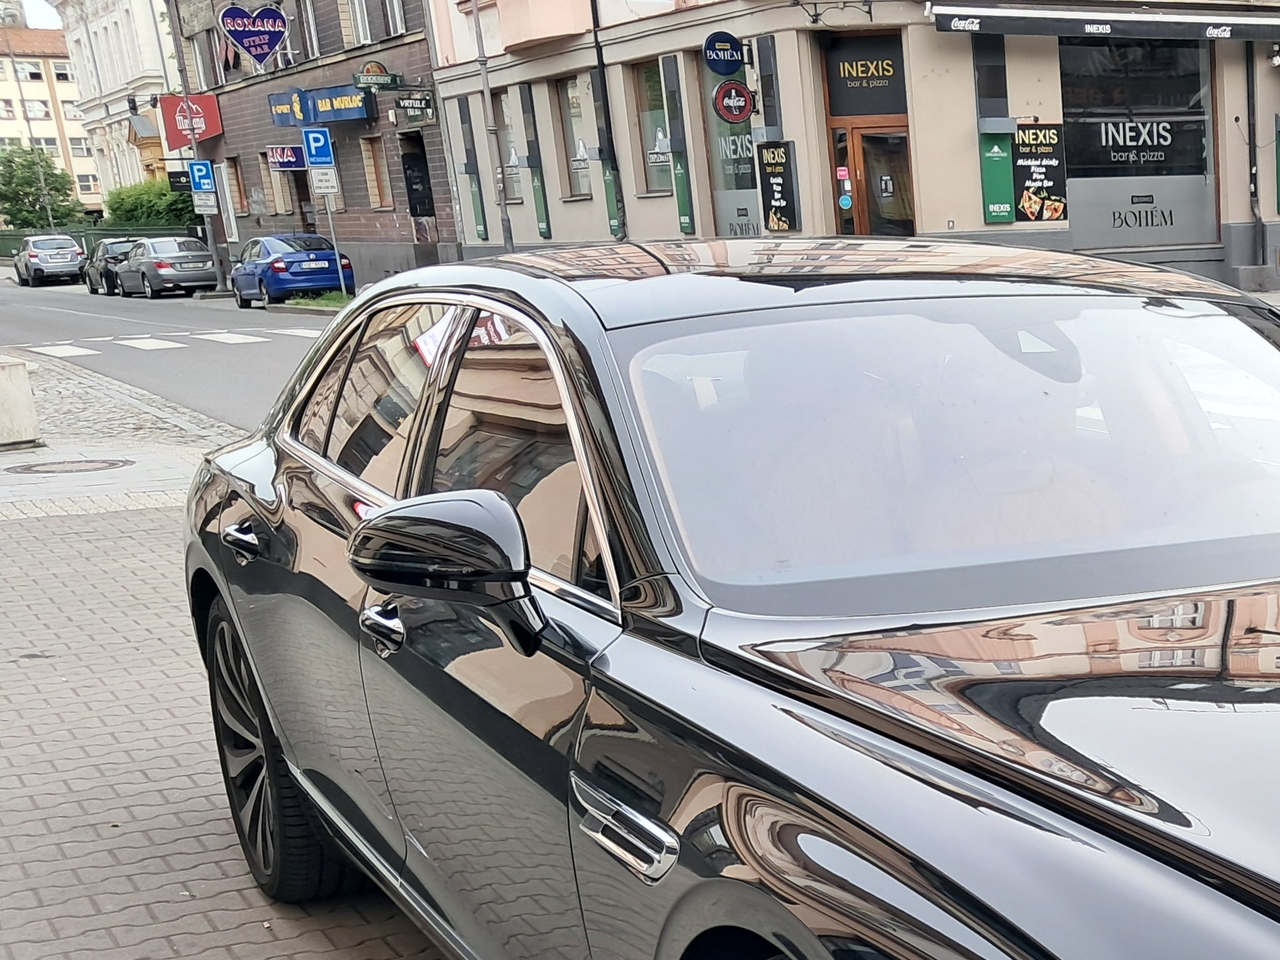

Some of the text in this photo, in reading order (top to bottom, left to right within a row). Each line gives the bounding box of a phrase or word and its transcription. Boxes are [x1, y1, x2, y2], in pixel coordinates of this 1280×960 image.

[224, 17, 286, 32] ROXANA
[950, 17, 981, 31] Coca-Cola
[1085, 23, 1112, 34] INEXIS
[1206, 25, 1233, 39] Coca-Cola
[242, 34, 270, 47] STRIP
[249, 45, 271, 56] BAR
[839, 60, 894, 78] INEXIS
[847, 78, 889, 88] bar & pizza
[318, 98, 332, 113] BAR
[1014, 129, 1059, 145] INEXIS
[1101, 121, 1173, 147] INEXIS
[308, 133, 325, 156] P
[718, 134, 753, 160] INEXIS
[1019, 145, 1031, 153] bar
[1037, 145, 1053, 154] pizza
[762, 147, 786, 164] INEXIS
[1140, 149, 1165, 164] pizza
[192, 165, 207, 183] P
[989, 203, 1011, 212] INEXIS
[1112, 206, 1175, 228] BOHÉM
